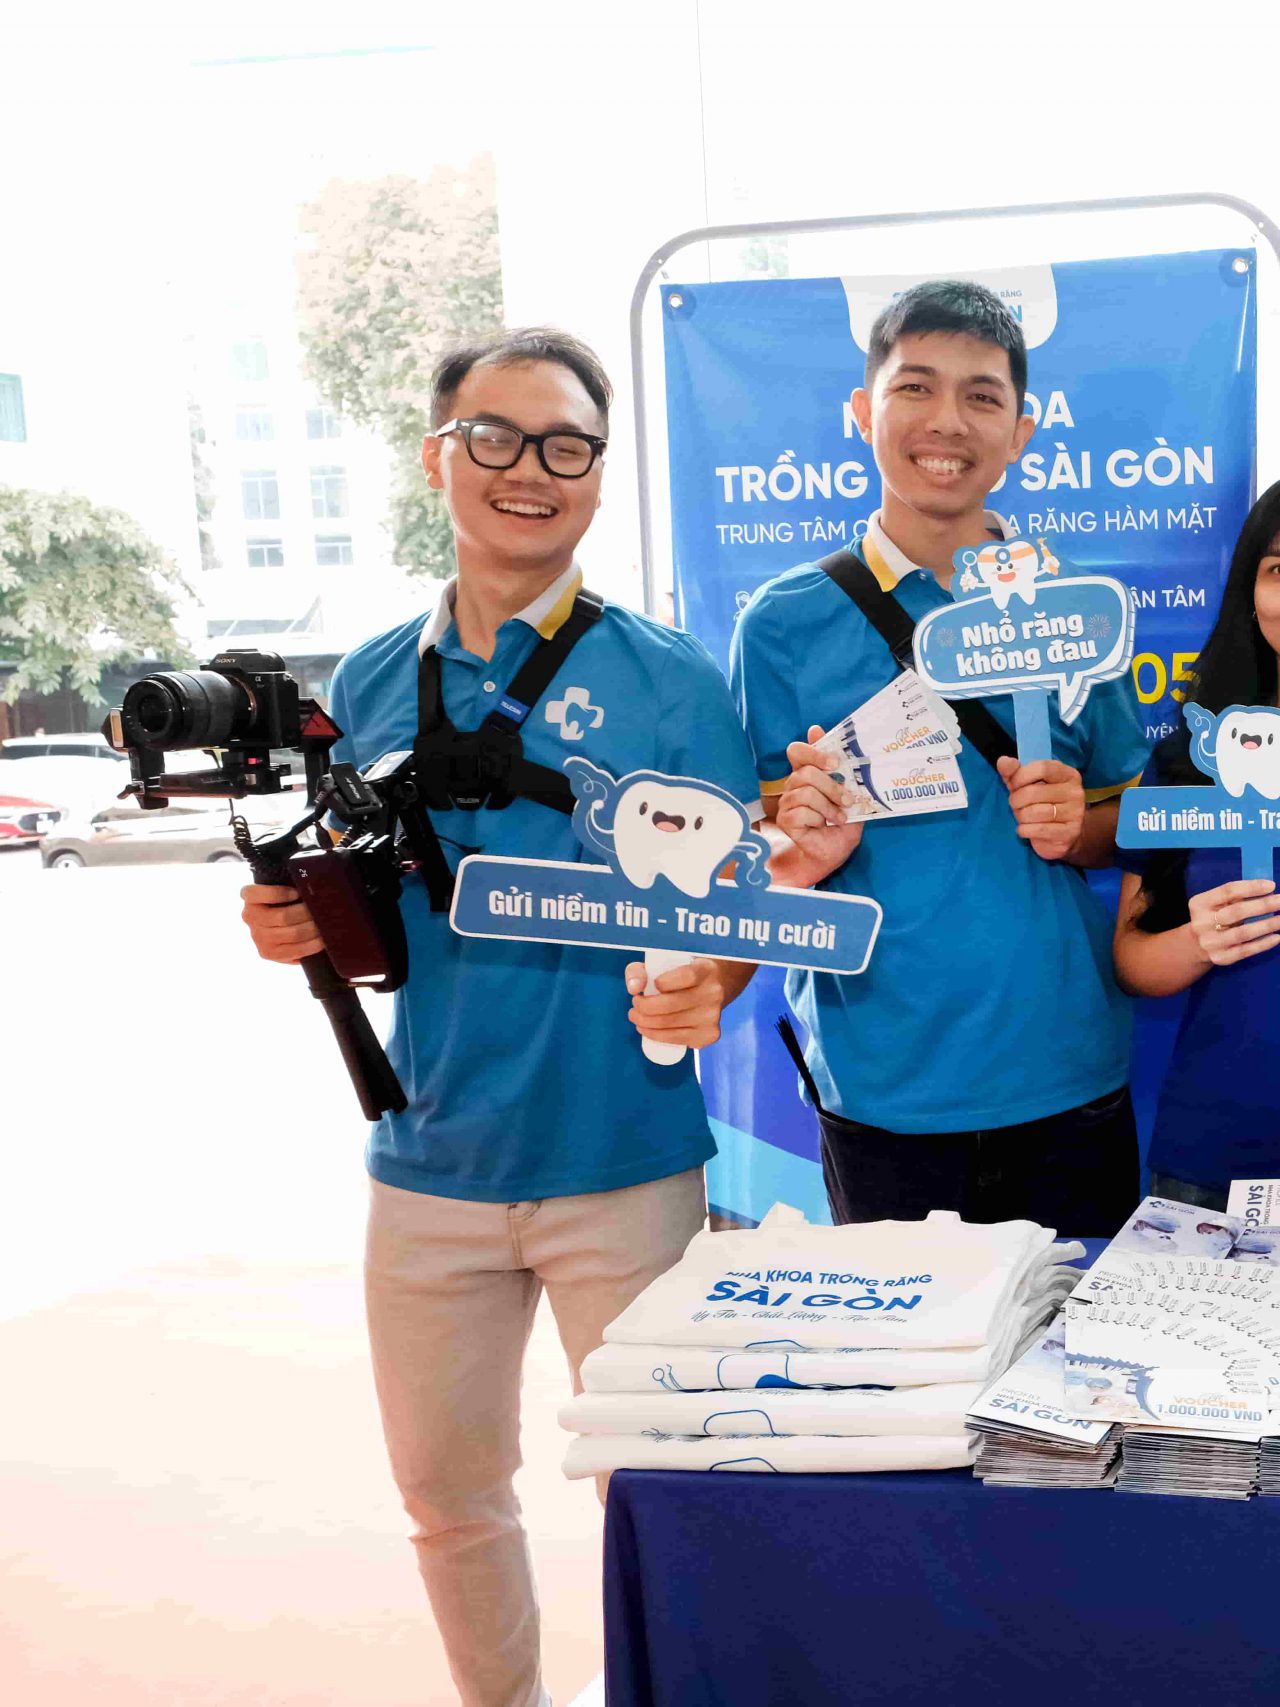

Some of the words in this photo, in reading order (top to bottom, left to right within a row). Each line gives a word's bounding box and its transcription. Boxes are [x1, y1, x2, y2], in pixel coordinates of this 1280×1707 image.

[715, 449, 868, 503] TRỒNG
[1020, 442, 1092, 492] SÀI
[1106, 437, 1214, 488] GÒN
[716, 522, 794, 545] TRUNG
[799, 515, 846, 542] TÂM
[1028, 507, 1097, 534] RĂNG
[1104, 504, 1159, 532] HÀM
[1167, 502, 1217, 534] MẶT
[1161, 584, 1206, 608] TÂM
[961, 610, 1016, 649] Nhổ
[1021, 611, 1085, 640] răng
[956, 647, 1042, 677] không
[1046, 639, 1099, 665] đau
[883, 726, 933, 753] VOUCHER
[925, 730, 948, 745] VND
[884, 784, 936, 802] 1.000.000
[937, 781, 960, 796] VND
[892, 773, 946, 787] VOUCHER
[1137, 806, 1167, 833] Gửi
[1171, 806, 1215, 831] niềm
[1220, 808, 1243, 830] tin
[488, 886, 533, 918] Gửi
[541, 892, 607, 925] niềm
[615, 901, 649, 928] tin
[675, 907, 730, 938] Trao
[738, 918, 770, 946] nụ
[778, 919, 837, 950] cười
[765, 1269, 813, 1284] KHOA
[705, 1280, 793, 1307] SÀI
[801, 1287, 923, 1312] GÒN
[1157, 1403, 1230, 1418] 1.000.000
[1233, 1409, 1263, 1422] VND
[1173, 1396, 1249, 1409] VOUCHER
